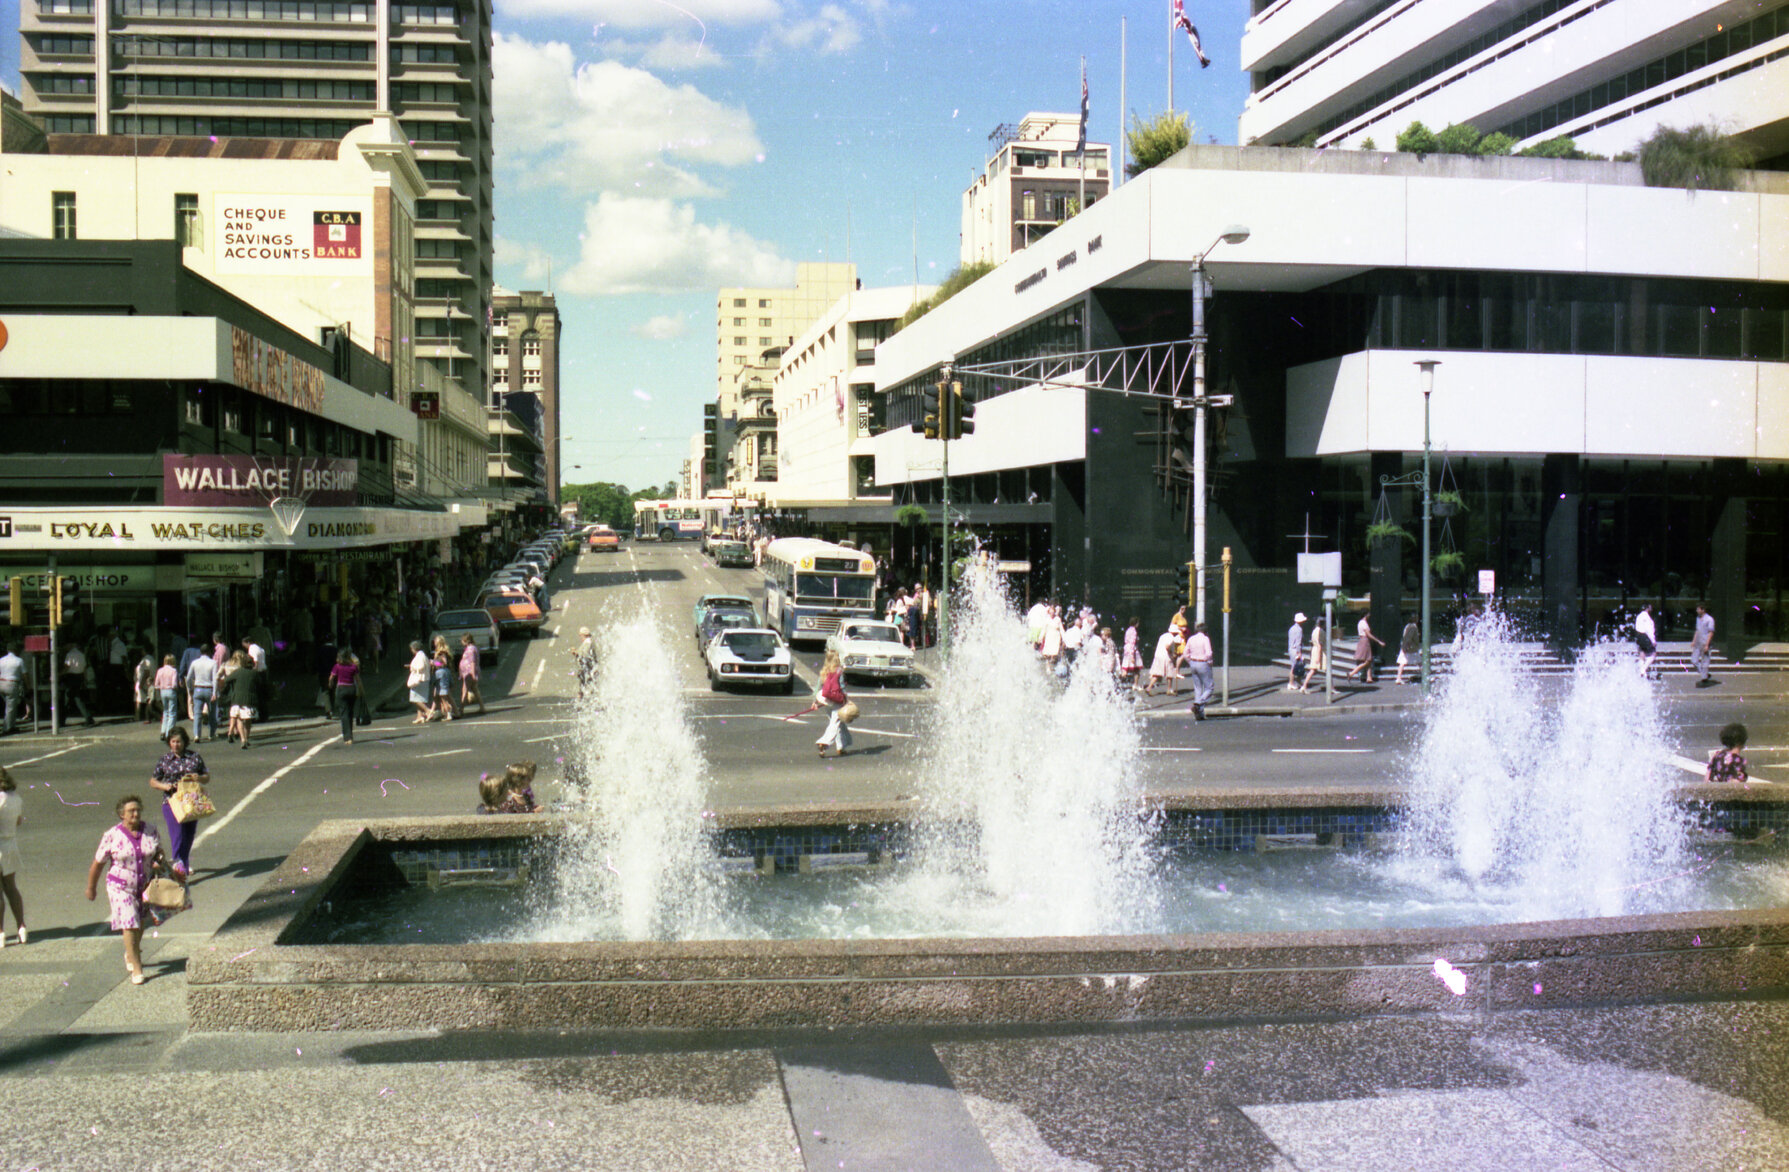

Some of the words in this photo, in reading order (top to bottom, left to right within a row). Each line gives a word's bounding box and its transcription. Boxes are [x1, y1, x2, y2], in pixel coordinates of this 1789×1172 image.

[224, 208, 286, 221] CHEQUE
[225, 222, 253, 230] AND
[225, 233, 293, 245] SAVINGS
[225, 248, 310, 259] ACCOUNTS
[317, 247, 357, 256] BANK
[175, 467, 289, 490] WALLACE
[303, 469, 355, 491] BISHOP
[51, 522, 134, 538] LOYAL
[152, 523, 265, 538] WATCHES
